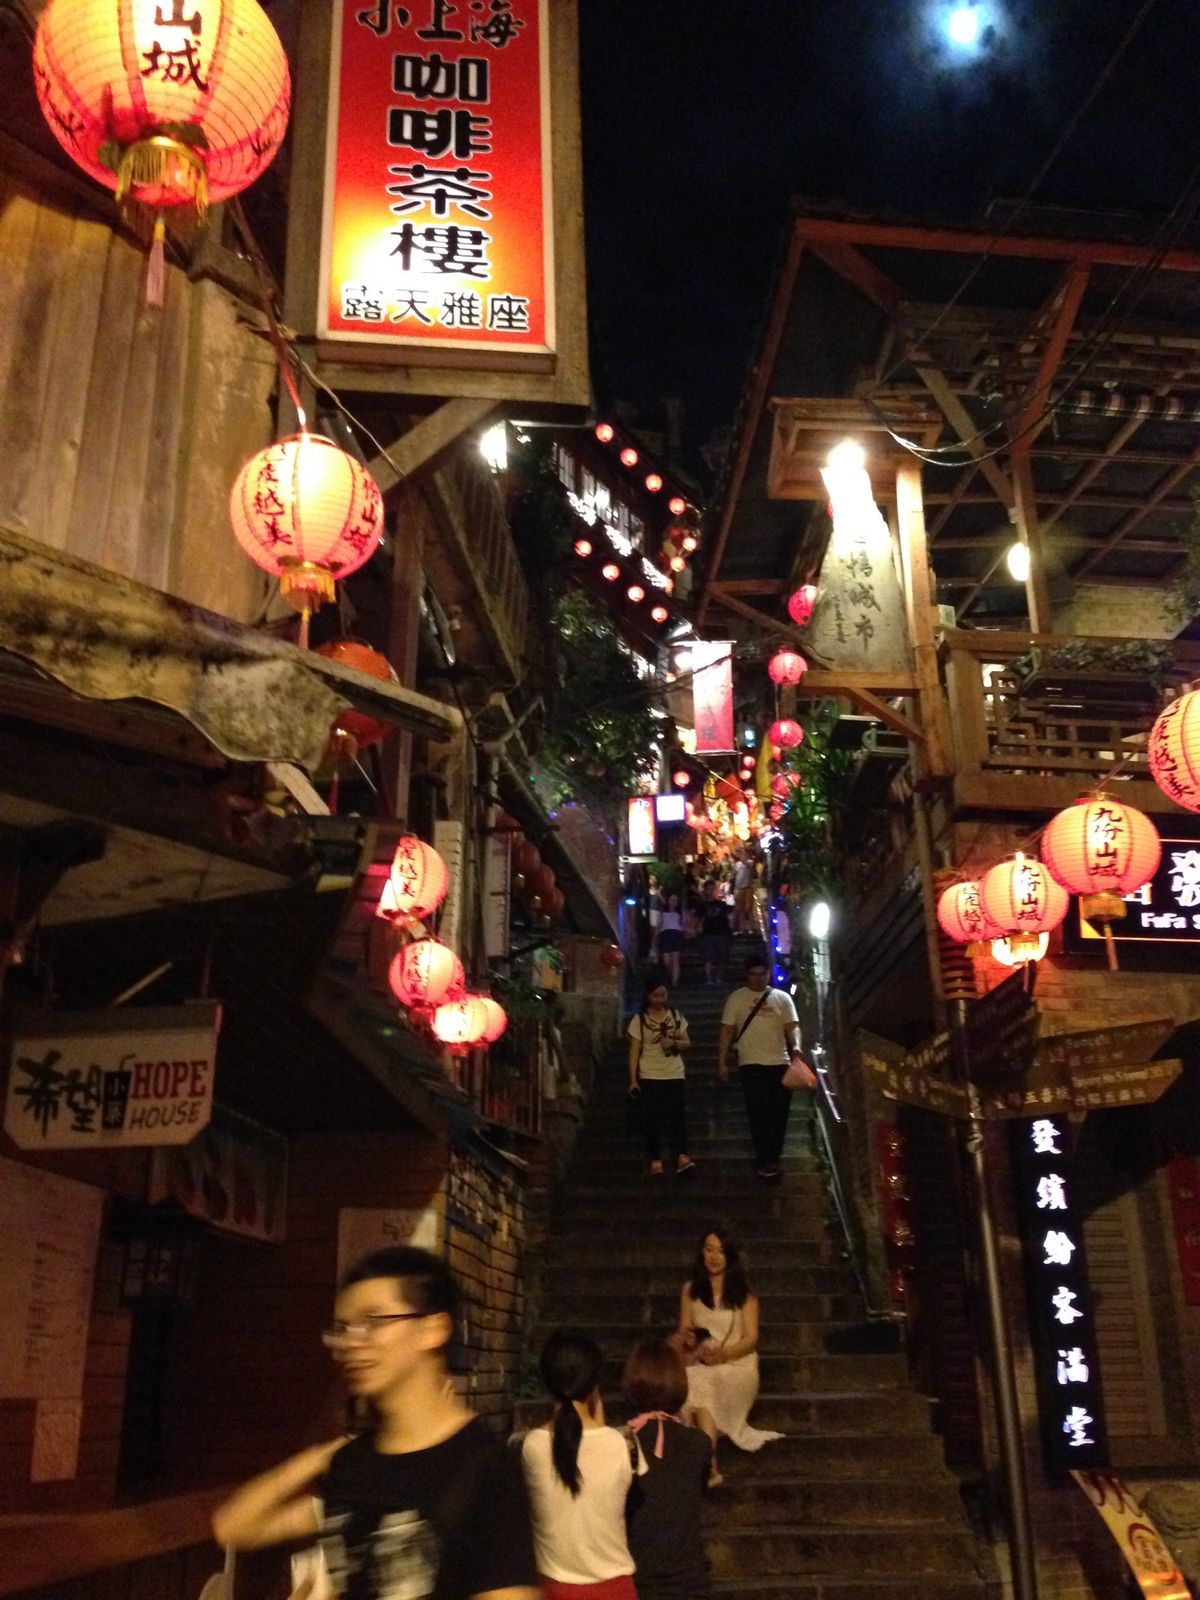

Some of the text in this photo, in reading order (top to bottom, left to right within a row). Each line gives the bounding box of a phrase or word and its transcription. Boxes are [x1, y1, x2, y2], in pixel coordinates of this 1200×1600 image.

[356, 0, 526, 49] 小上海
[387, 53, 493, 279] 咖啡茶樓
[343, 285, 530, 332] 露天雅座
[1090, 806, 1123, 879] 九份山城
[1016, 864, 1042, 922] 九份山城
[131, 1060, 208, 1100] HOPE
[129, 1101, 202, 1131] HOUSE
